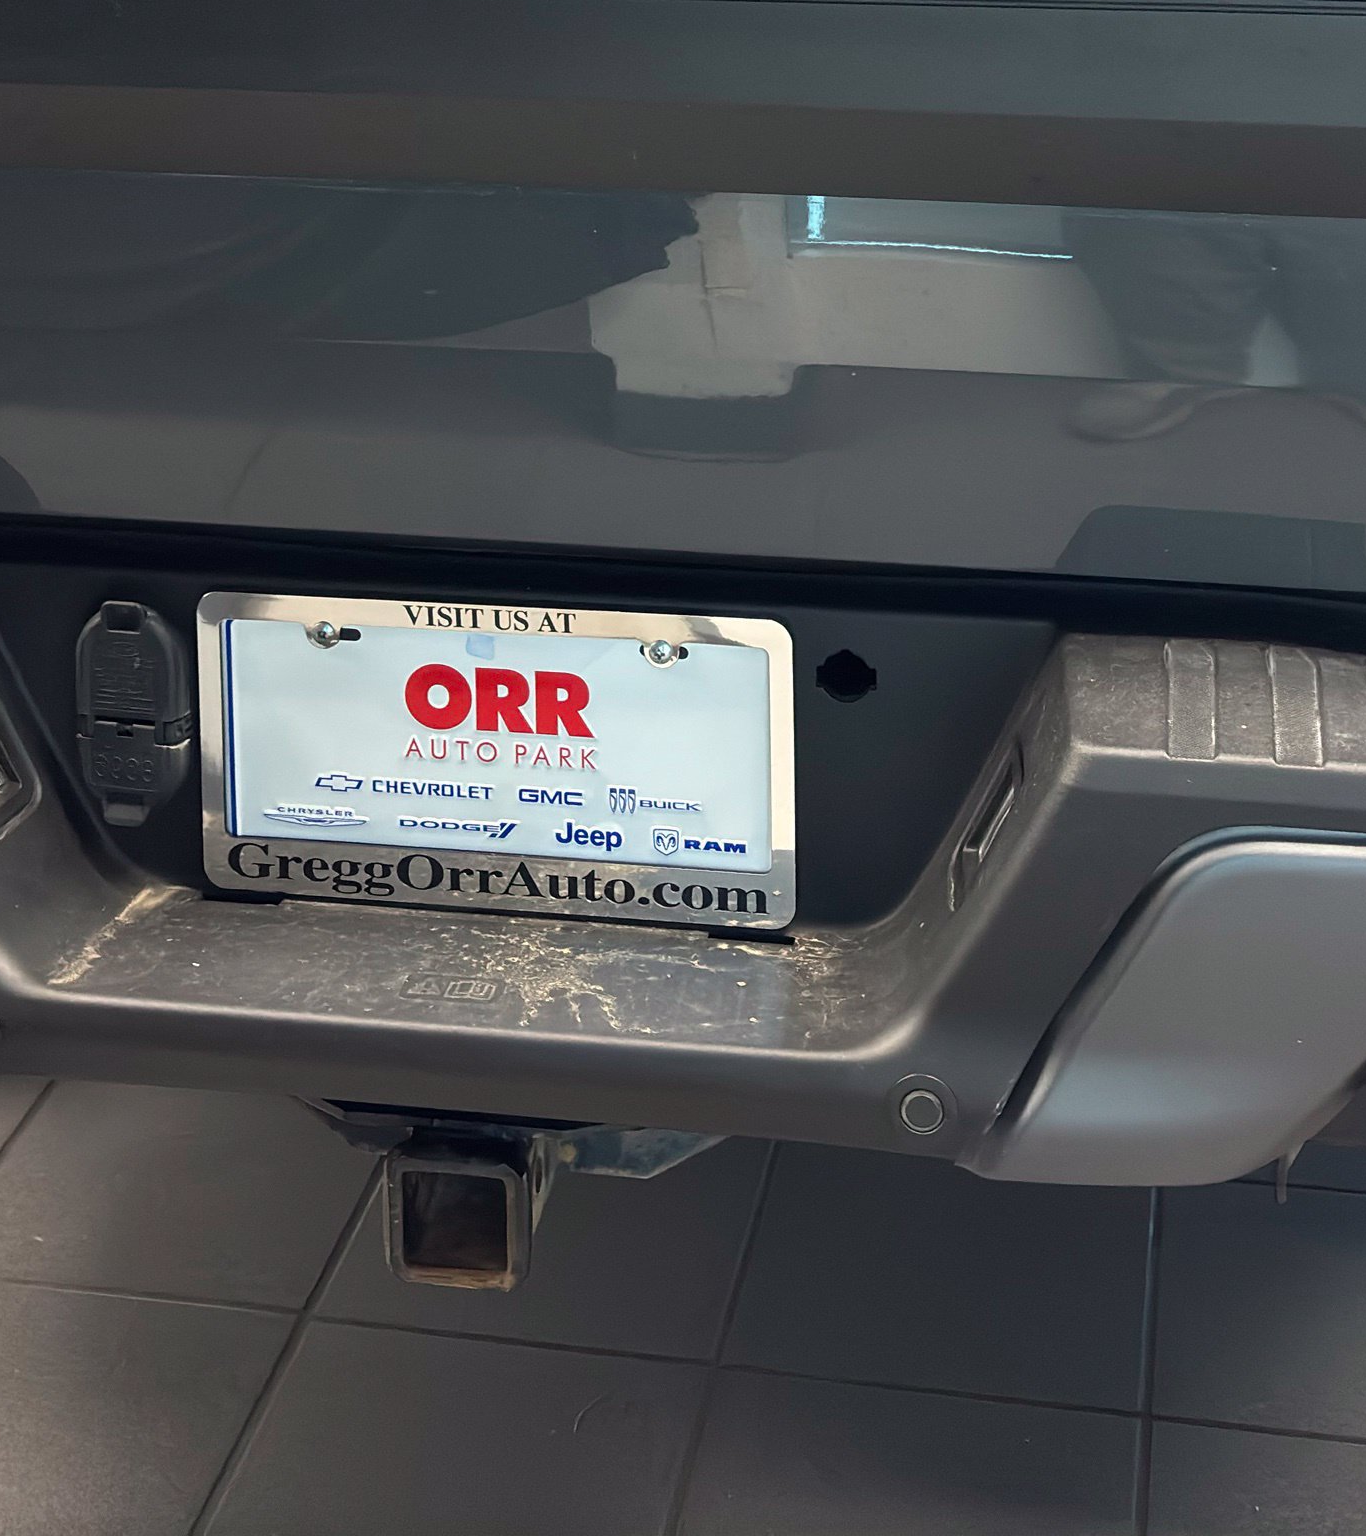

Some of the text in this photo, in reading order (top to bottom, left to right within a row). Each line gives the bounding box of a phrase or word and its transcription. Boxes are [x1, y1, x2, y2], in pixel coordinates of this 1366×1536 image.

[404, 605, 577, 635] VISIT US AT
[405, 664, 595, 738] ORR
[405, 738, 597, 770] AUTO PARK
[372, 779, 494, 801] CHEVROLET
[519, 789, 583, 806] GMC
[276, 806, 354, 817] CHRYSLER
[639, 799, 702, 812] BUICK
[400, 819, 497, 833] DODGE
[555, 821, 623, 852] Jeep
[684, 837, 747, 855] RAM
[227, 843, 769, 914] GreggOrrAuto.com
